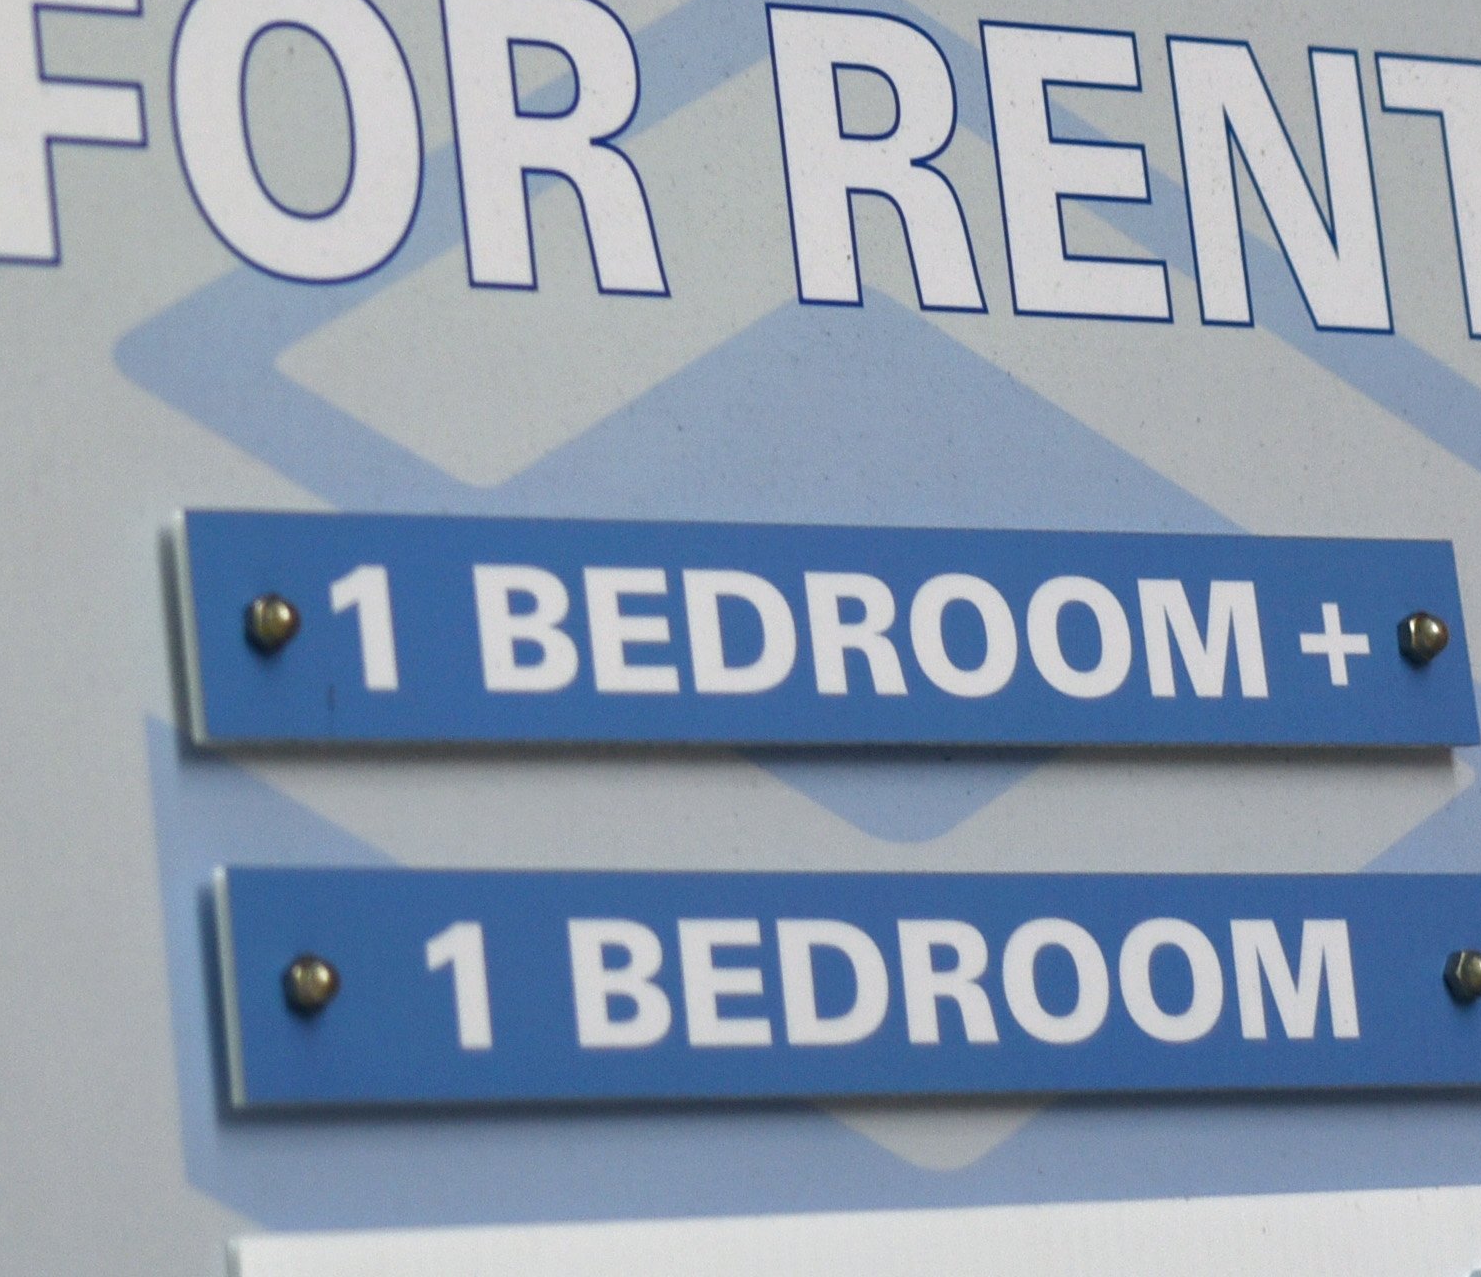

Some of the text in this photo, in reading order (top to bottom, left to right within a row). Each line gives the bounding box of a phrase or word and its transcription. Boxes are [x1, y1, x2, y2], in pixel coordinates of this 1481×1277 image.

[326, 564, 1371, 699] 1 BEDROOM +
[424, 918, 1361, 1050] 1 BEDROOM
